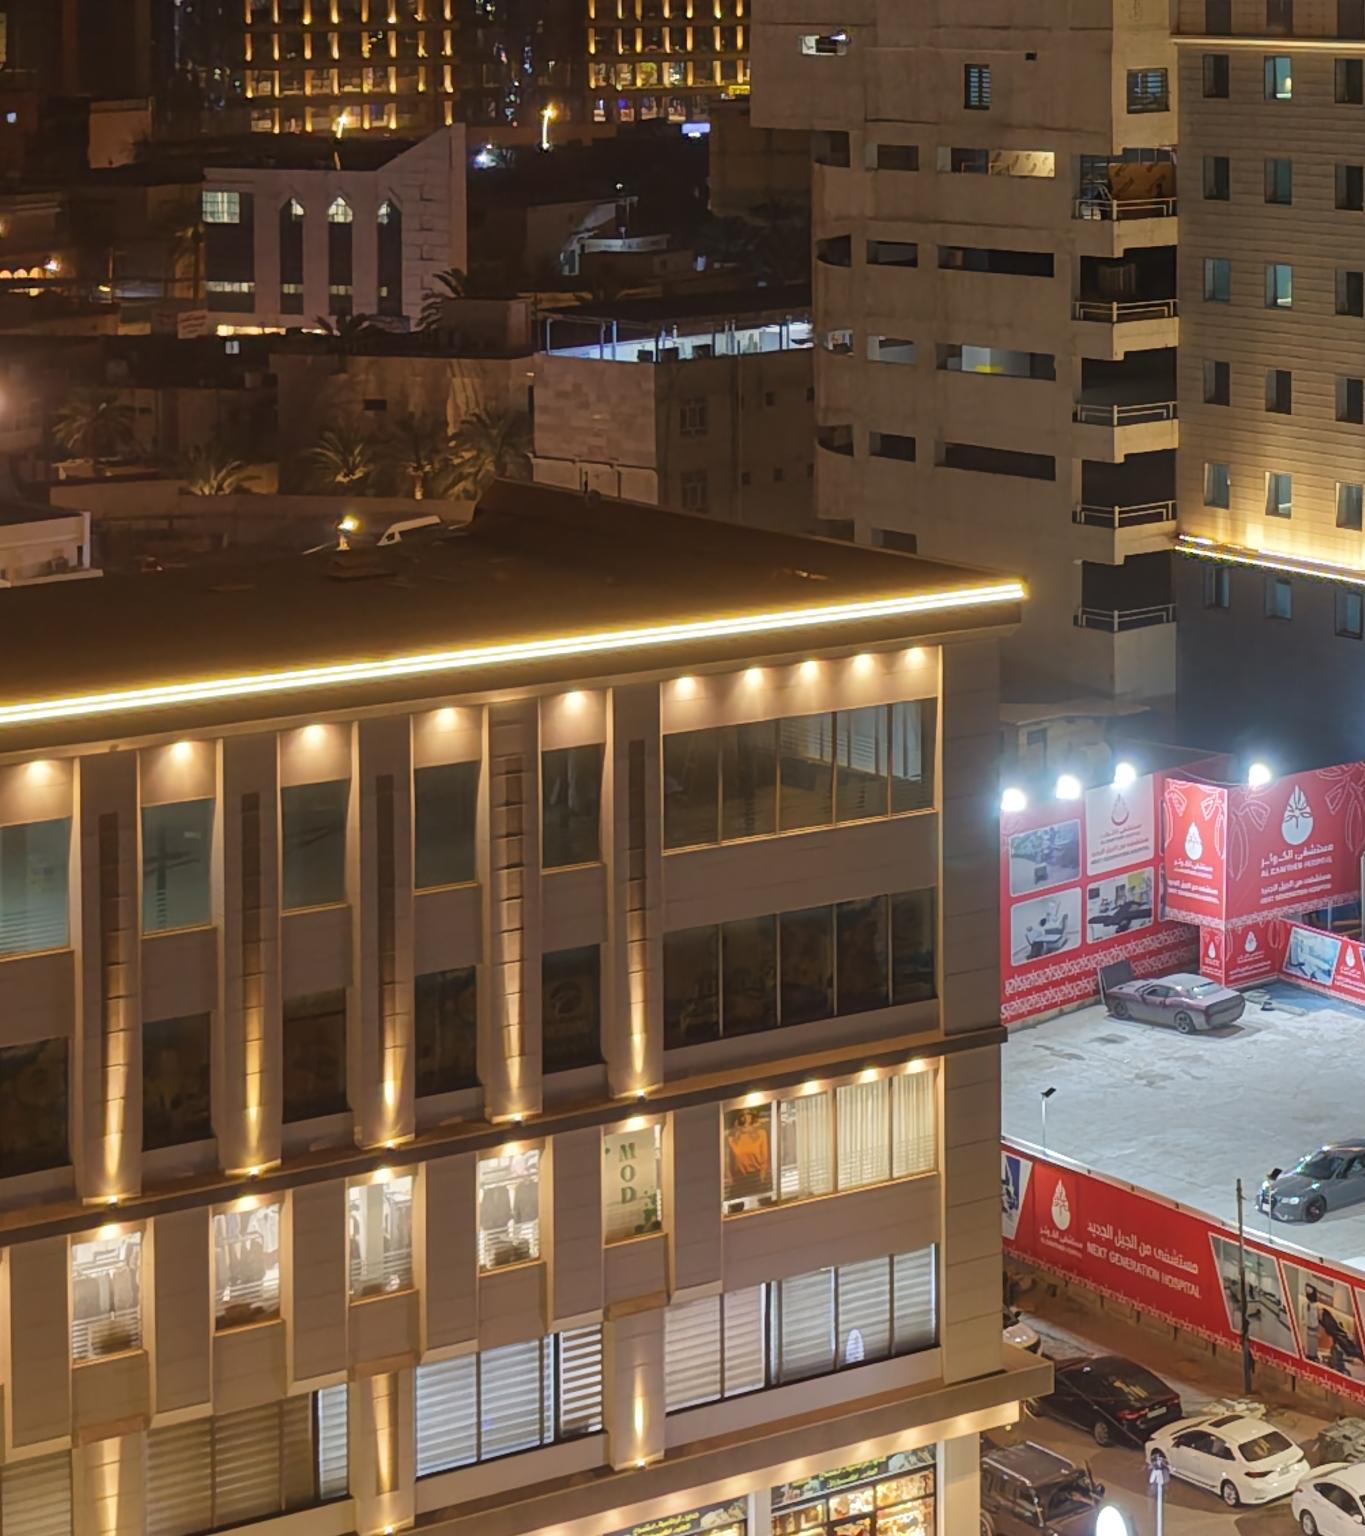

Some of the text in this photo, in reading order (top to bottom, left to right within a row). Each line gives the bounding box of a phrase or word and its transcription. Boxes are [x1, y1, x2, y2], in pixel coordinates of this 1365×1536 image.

[1086, 1241, 1108, 1260] NEXT
[1108, 1250, 1161, 1283] GENERATION
[1160, 1272, 1202, 1299] HOSPITAL
[1087, 1221, 1199, 1274] مستشفى من الجيل الجديد
